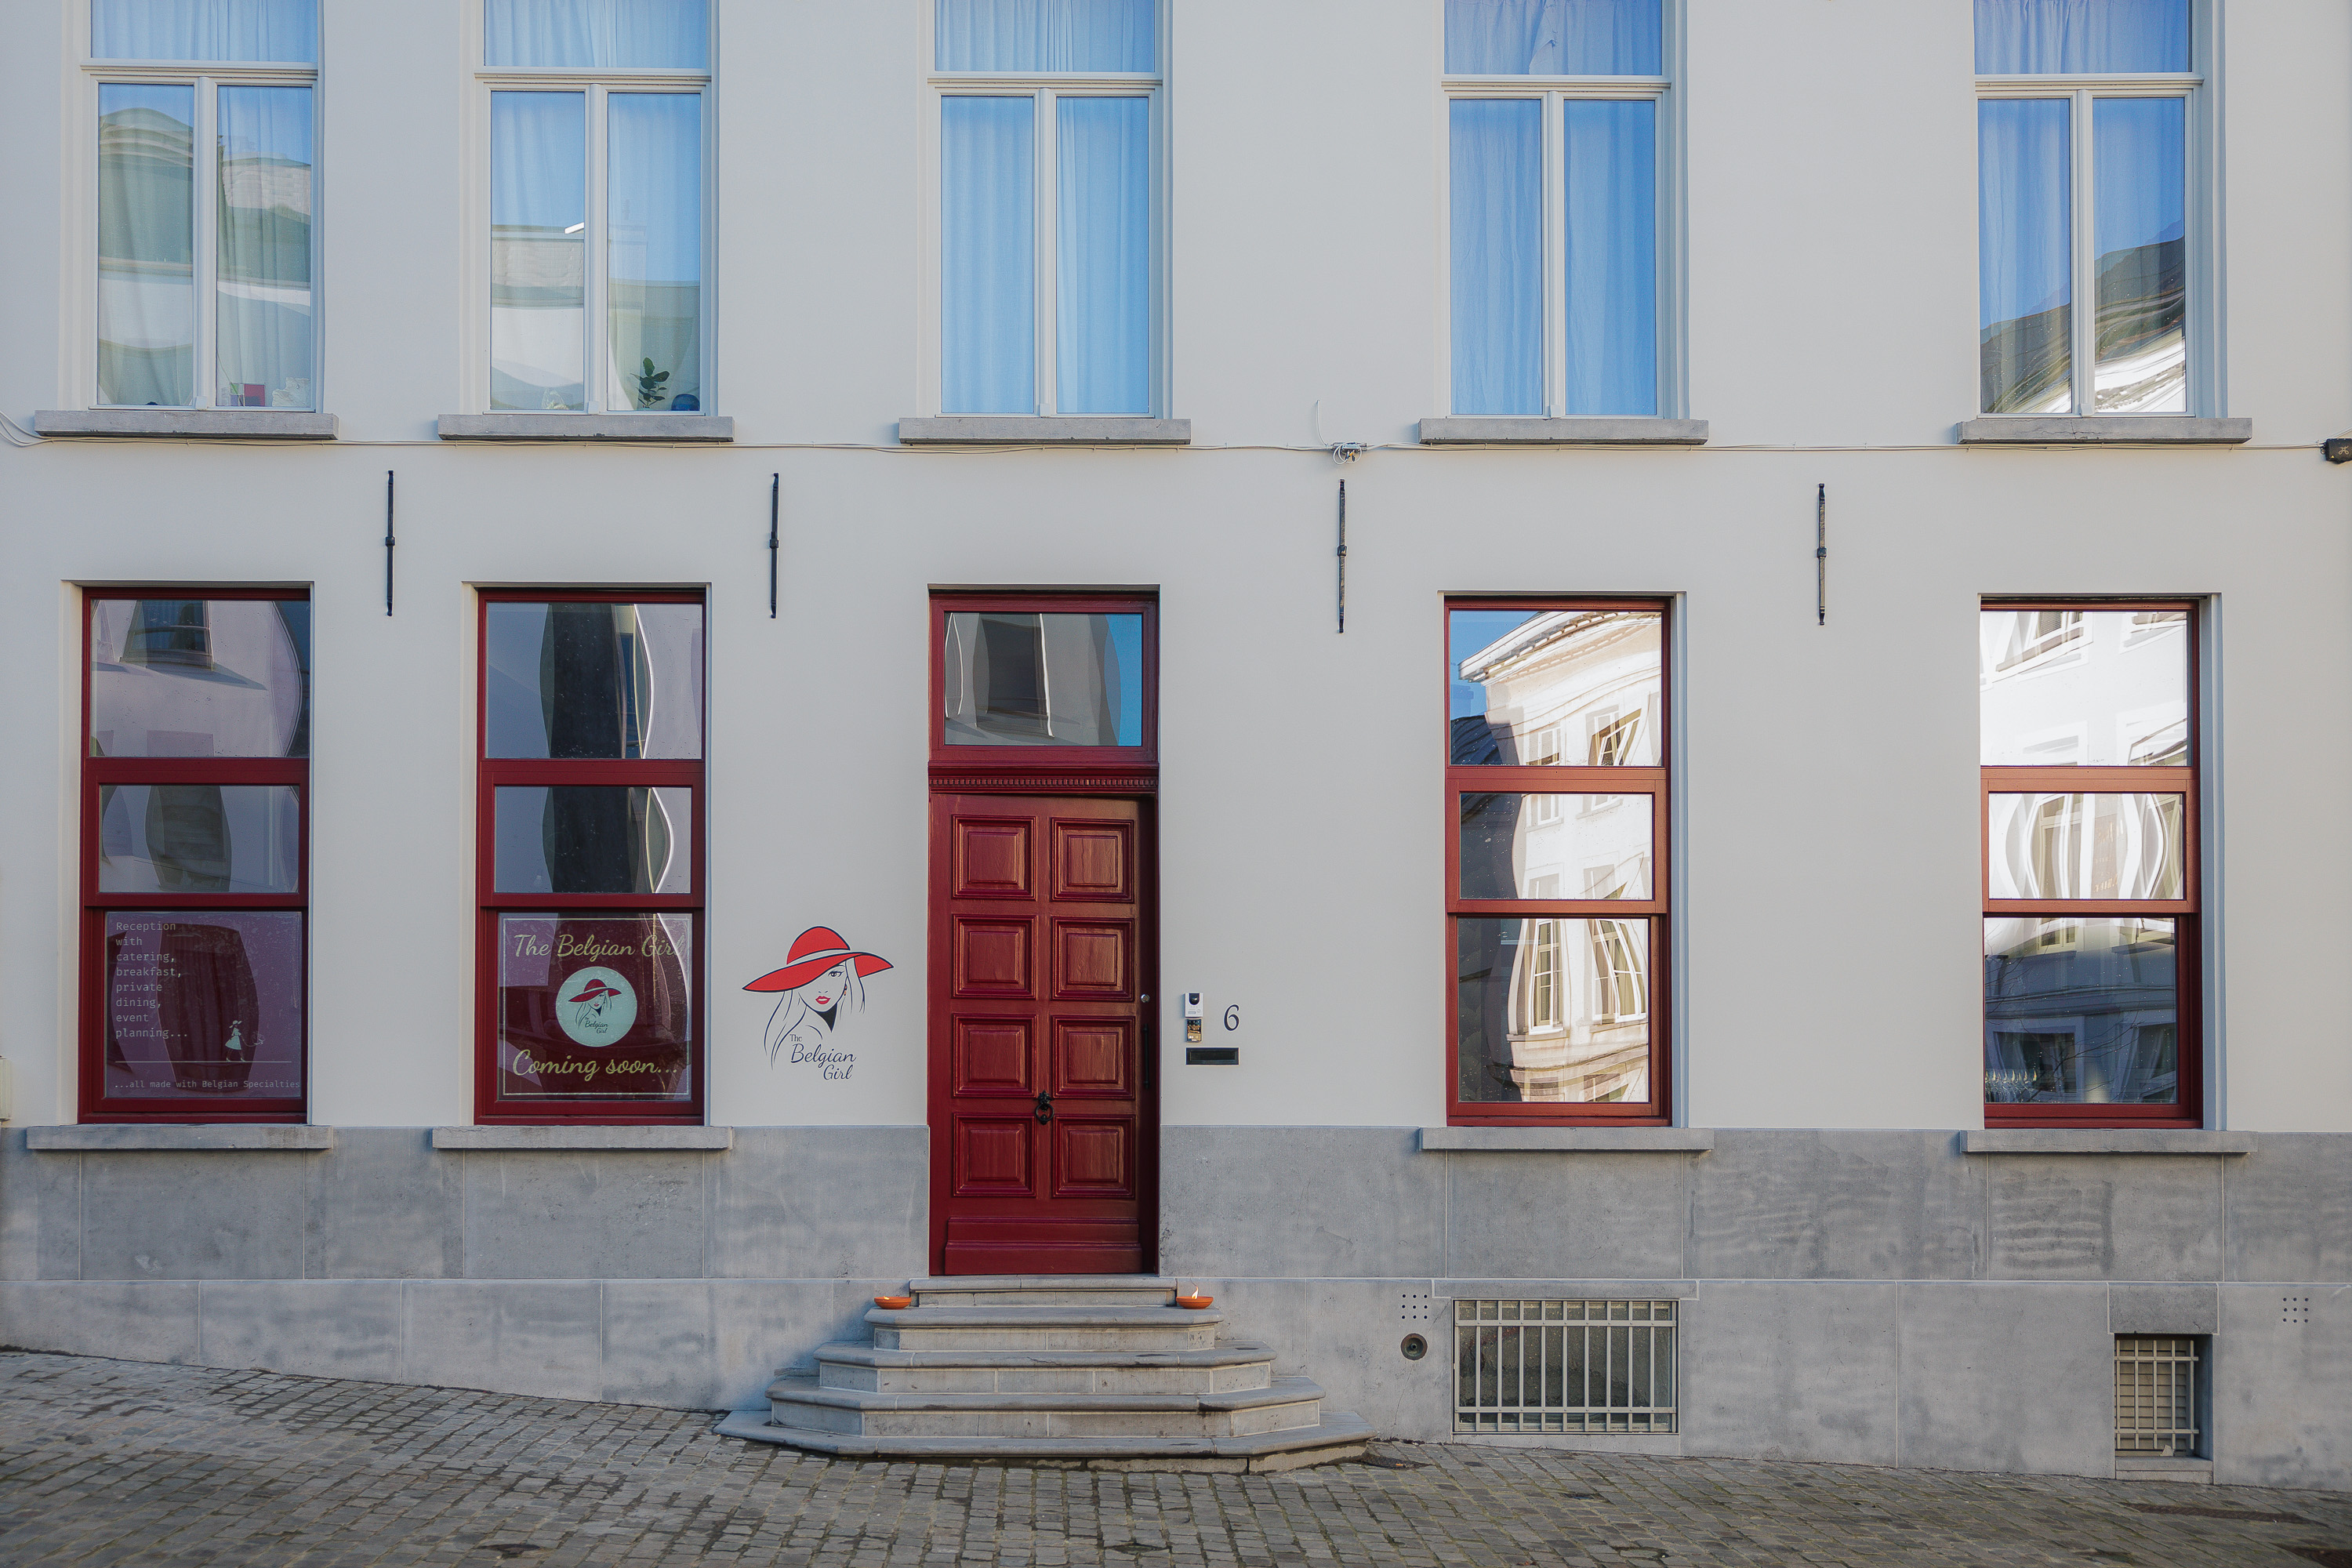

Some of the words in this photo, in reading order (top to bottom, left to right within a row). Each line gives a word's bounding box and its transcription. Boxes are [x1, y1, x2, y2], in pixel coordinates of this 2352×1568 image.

[115, 921, 176, 933] Reception
[115, 936, 143, 946] with
[514, 934, 551, 957] The
[557, 934, 636, 963] Belgian
[641, 934, 685, 957] Girl
[115, 951, 176, 964] catering,
[115, 966, 182, 978] breakfast,
[115, 982, 163, 993] private
[115, 997, 162, 1009] dining,
[115, 1014, 149, 1022] event
[1223, 1004, 1240, 1032] 6
[584, 1020, 609, 1029] Belgian
[115, 1028, 188, 1040] planning...
[789, 1033, 803, 1042] The
[790, 1043, 857, 1069] Belgian
[513, 1049, 601, 1081] Coming
[604, 1058, 678, 1074] soon...
[822, 1064, 854, 1080] Girl
[150, 1080, 171, 1088] made
[176, 1080, 197, 1088] with
[201, 1080, 238, 1091] Belgian
[243, 1080, 301, 1091] Specialties
